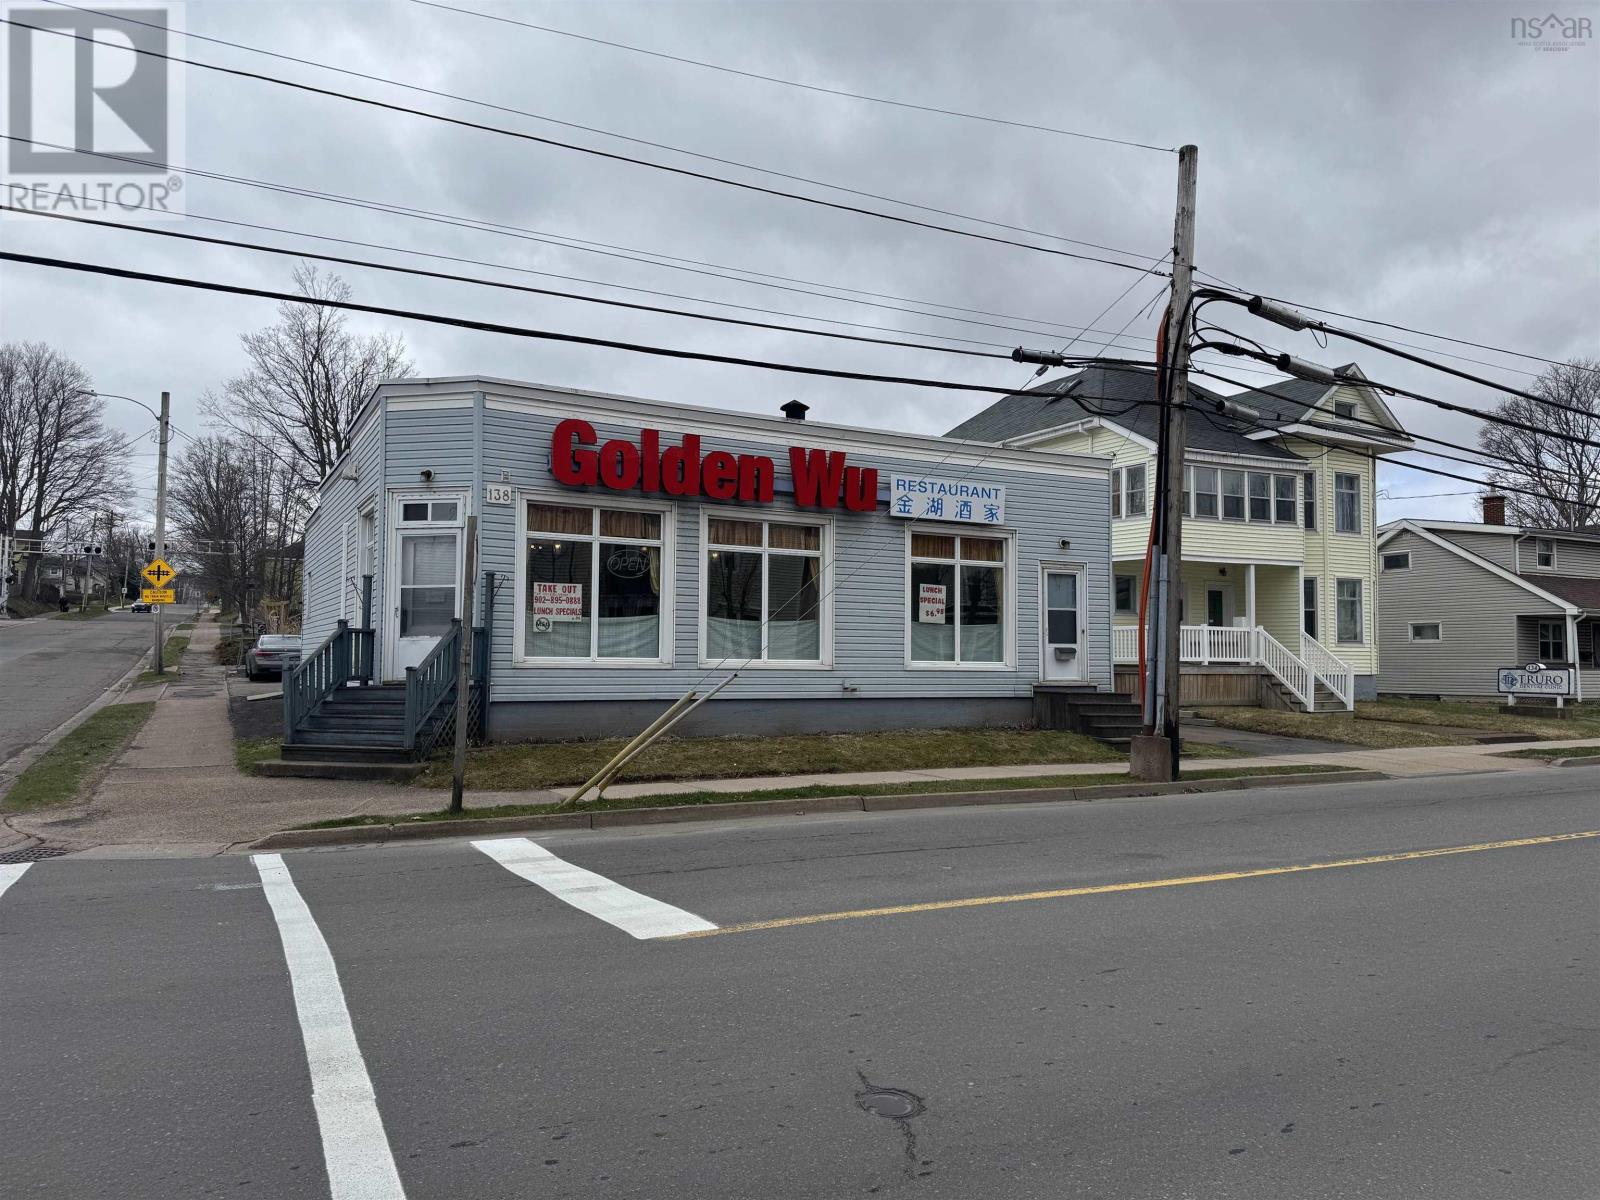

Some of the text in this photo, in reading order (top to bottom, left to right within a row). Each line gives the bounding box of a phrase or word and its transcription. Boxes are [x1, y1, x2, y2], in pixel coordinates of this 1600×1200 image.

[552, 418, 878, 512] Golden Wu
[488, 489, 509, 501] 138
[896, 479, 1001, 500] RESTAURANT
[896, 494, 1000, 522] 金湖酒家
[610, 556, 648, 571] OPEN
[537, 584, 577, 593] TAKE OUT
[922, 586, 942, 594] LUNCH
[534, 607, 553, 615] LUNCH
[1518, 675, 1563, 684] TRURO
